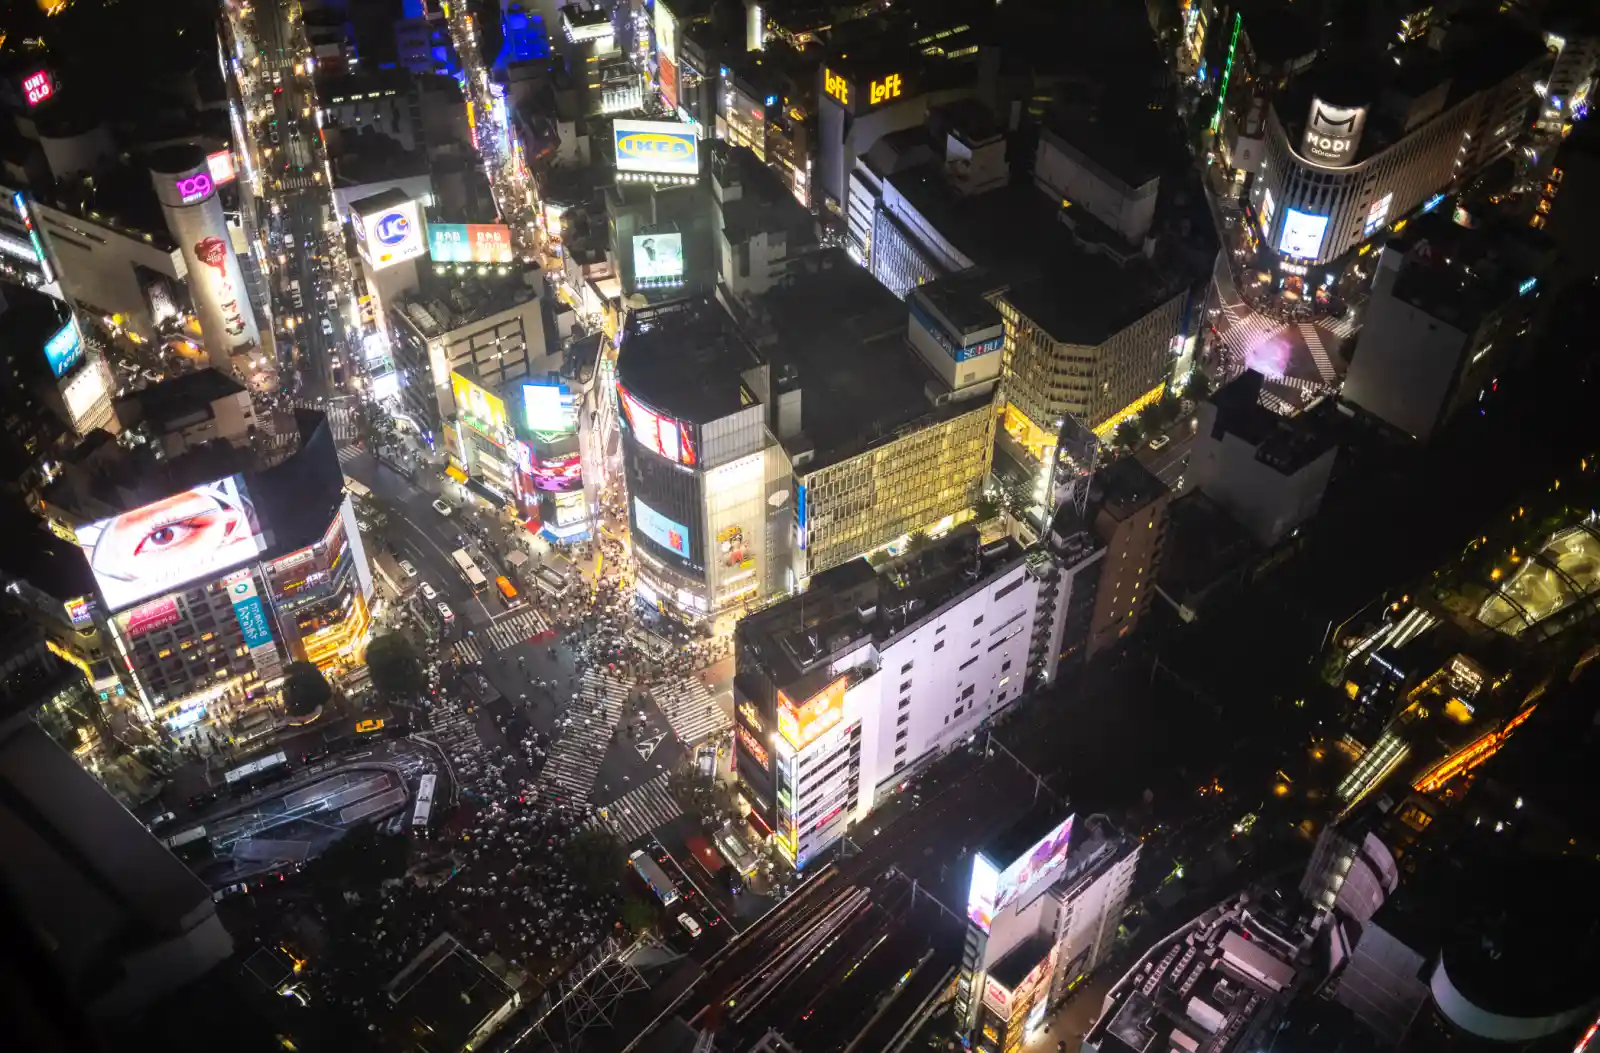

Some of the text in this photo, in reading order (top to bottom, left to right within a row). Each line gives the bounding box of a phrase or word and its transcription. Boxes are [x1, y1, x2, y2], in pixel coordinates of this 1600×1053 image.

[24, 73, 45, 91] UNI
[29, 85, 49, 102] QLO
[625, 139, 688, 154] IKEA
[1307, 132, 1351, 152] MODI
[175, 174, 211, 198] 109
[963, 339, 1000, 360] SEIBU
